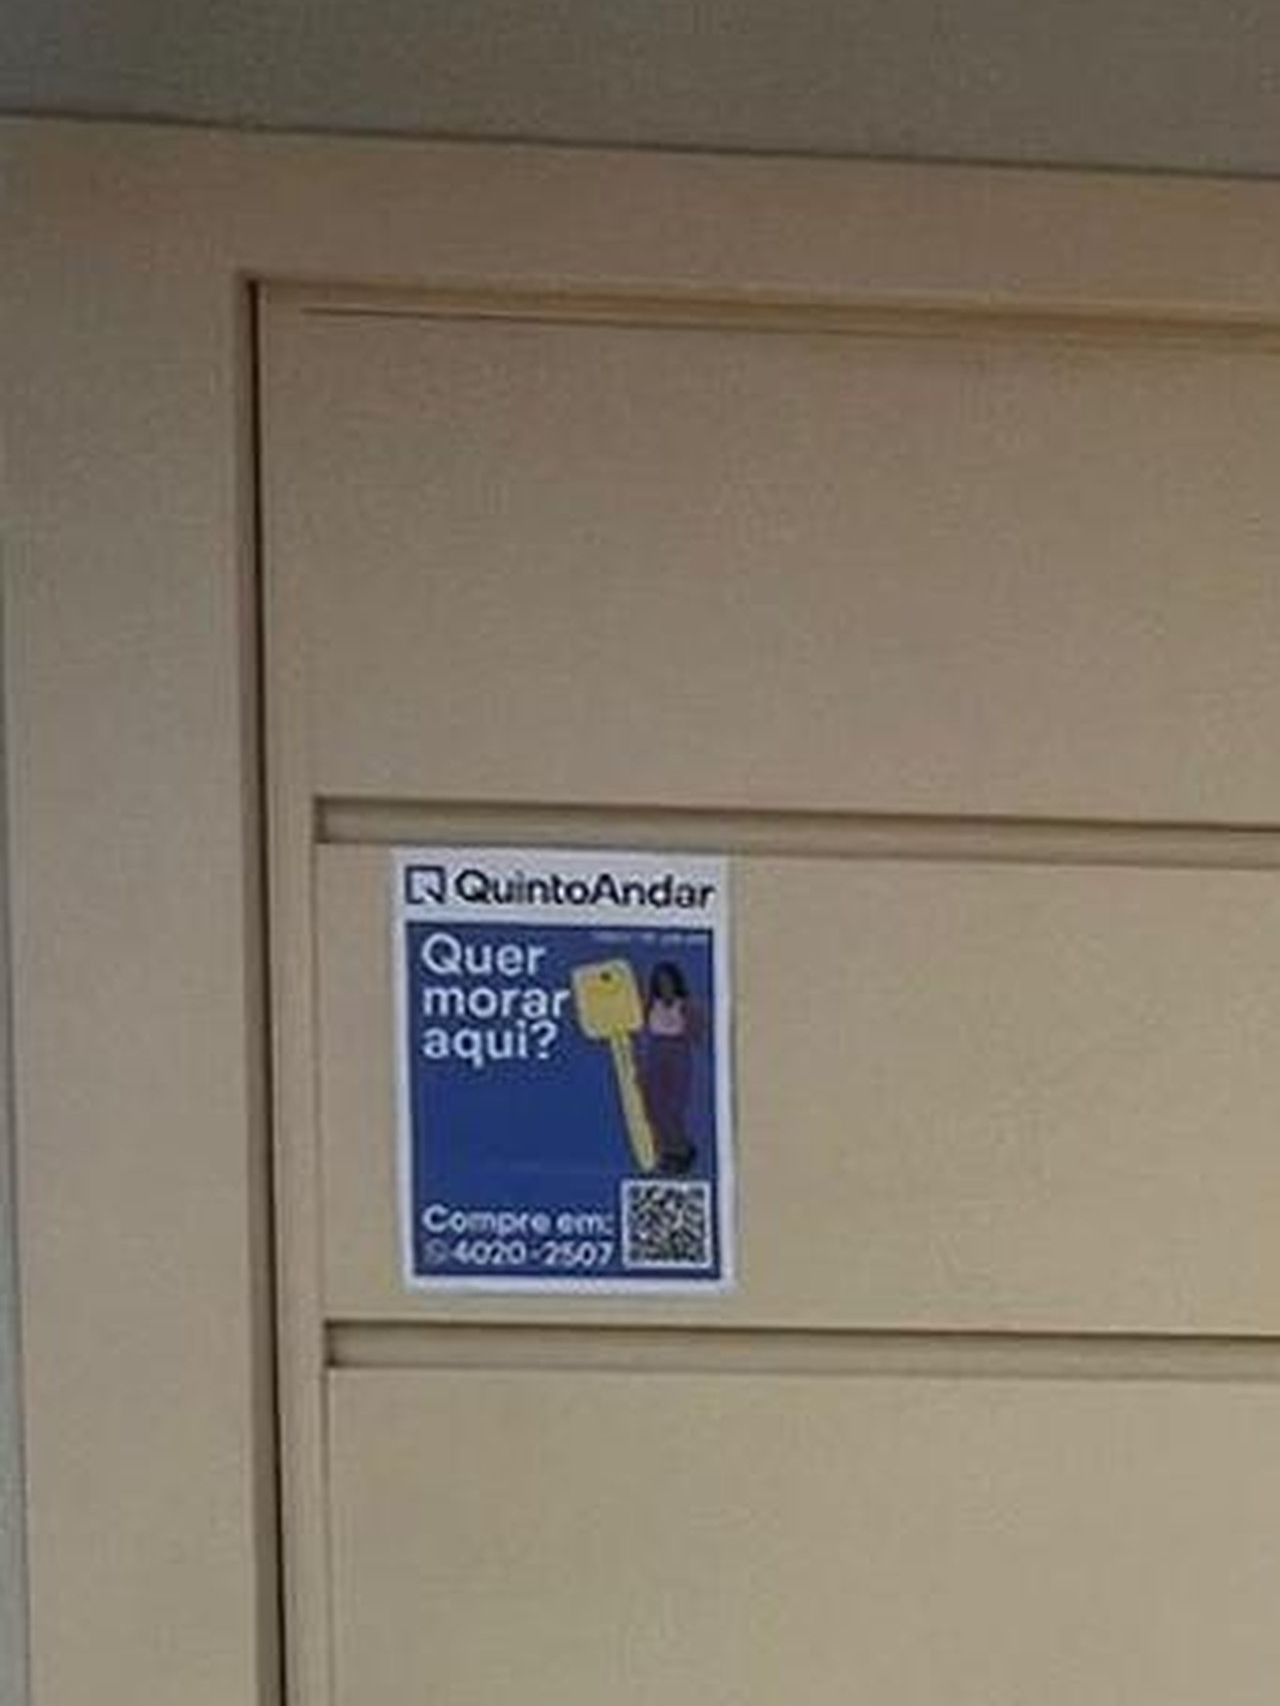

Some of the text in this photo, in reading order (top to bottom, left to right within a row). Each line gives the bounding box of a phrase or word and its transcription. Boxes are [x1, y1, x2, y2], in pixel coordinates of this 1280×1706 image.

[454, 868, 716, 909] QuintoAndar
[421, 932, 547, 976] Quer
[422, 984, 571, 1018] morar
[422, 1020, 558, 1068] aqui?
[422, 1204, 551, 1238] Compre
